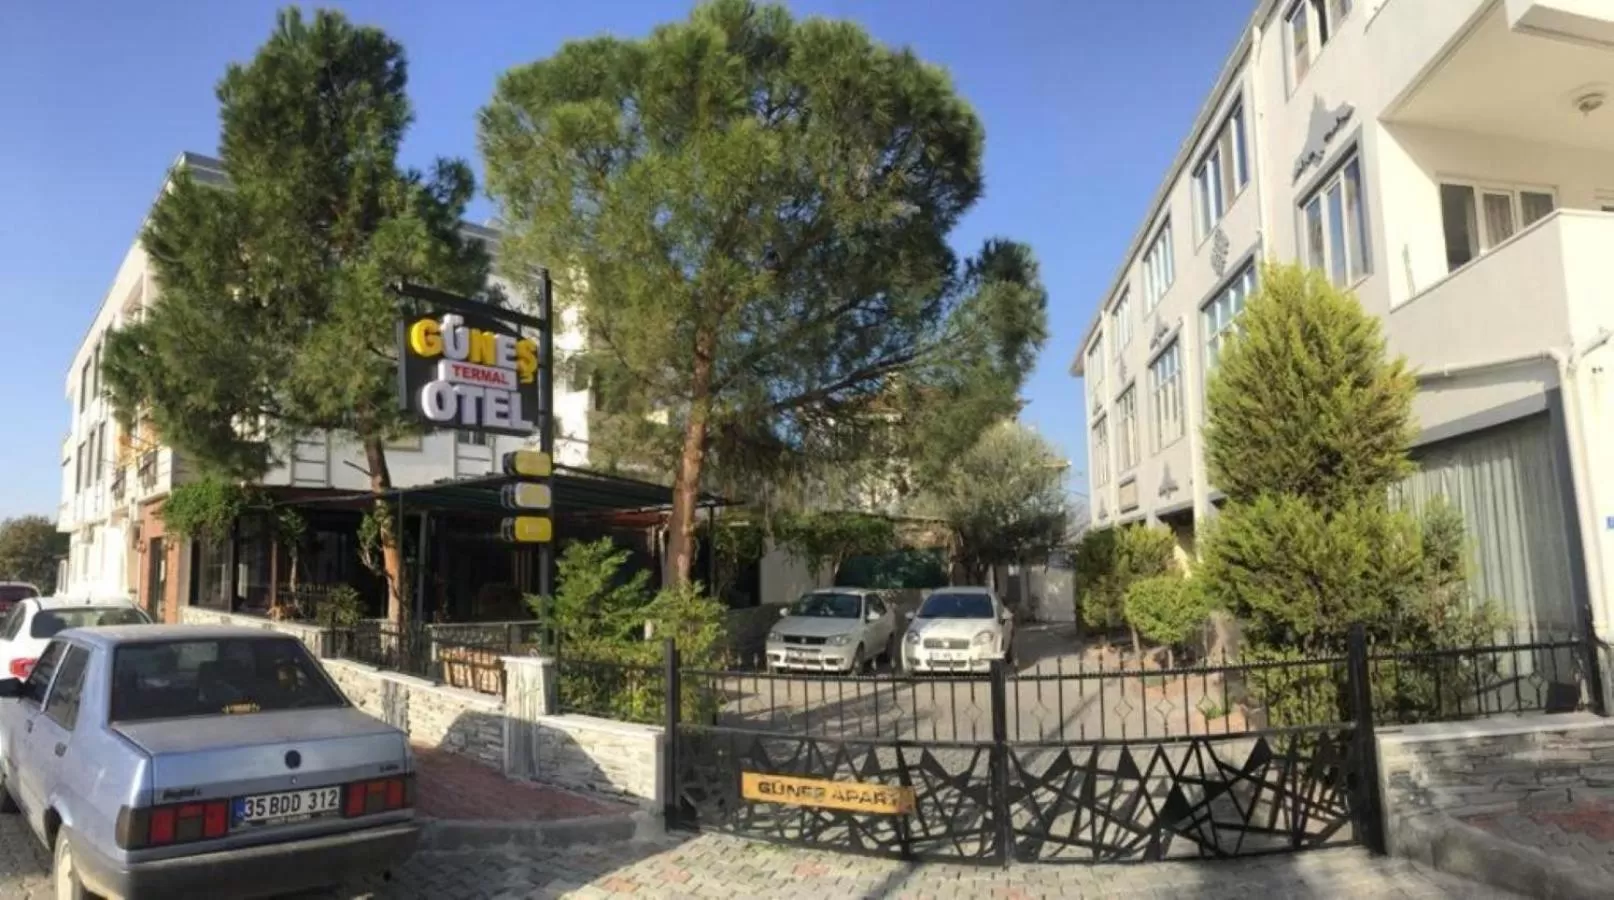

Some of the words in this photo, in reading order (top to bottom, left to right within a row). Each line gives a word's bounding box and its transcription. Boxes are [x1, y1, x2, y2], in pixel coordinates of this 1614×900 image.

[411, 312, 538, 384] GÜNEŞ
[451, 364, 510, 385] TERMAL
[421, 380, 534, 430] OTEL
[245, 799, 266, 818] 35
[269, 794, 302, 815] BDD
[308, 789, 338, 810] 312
